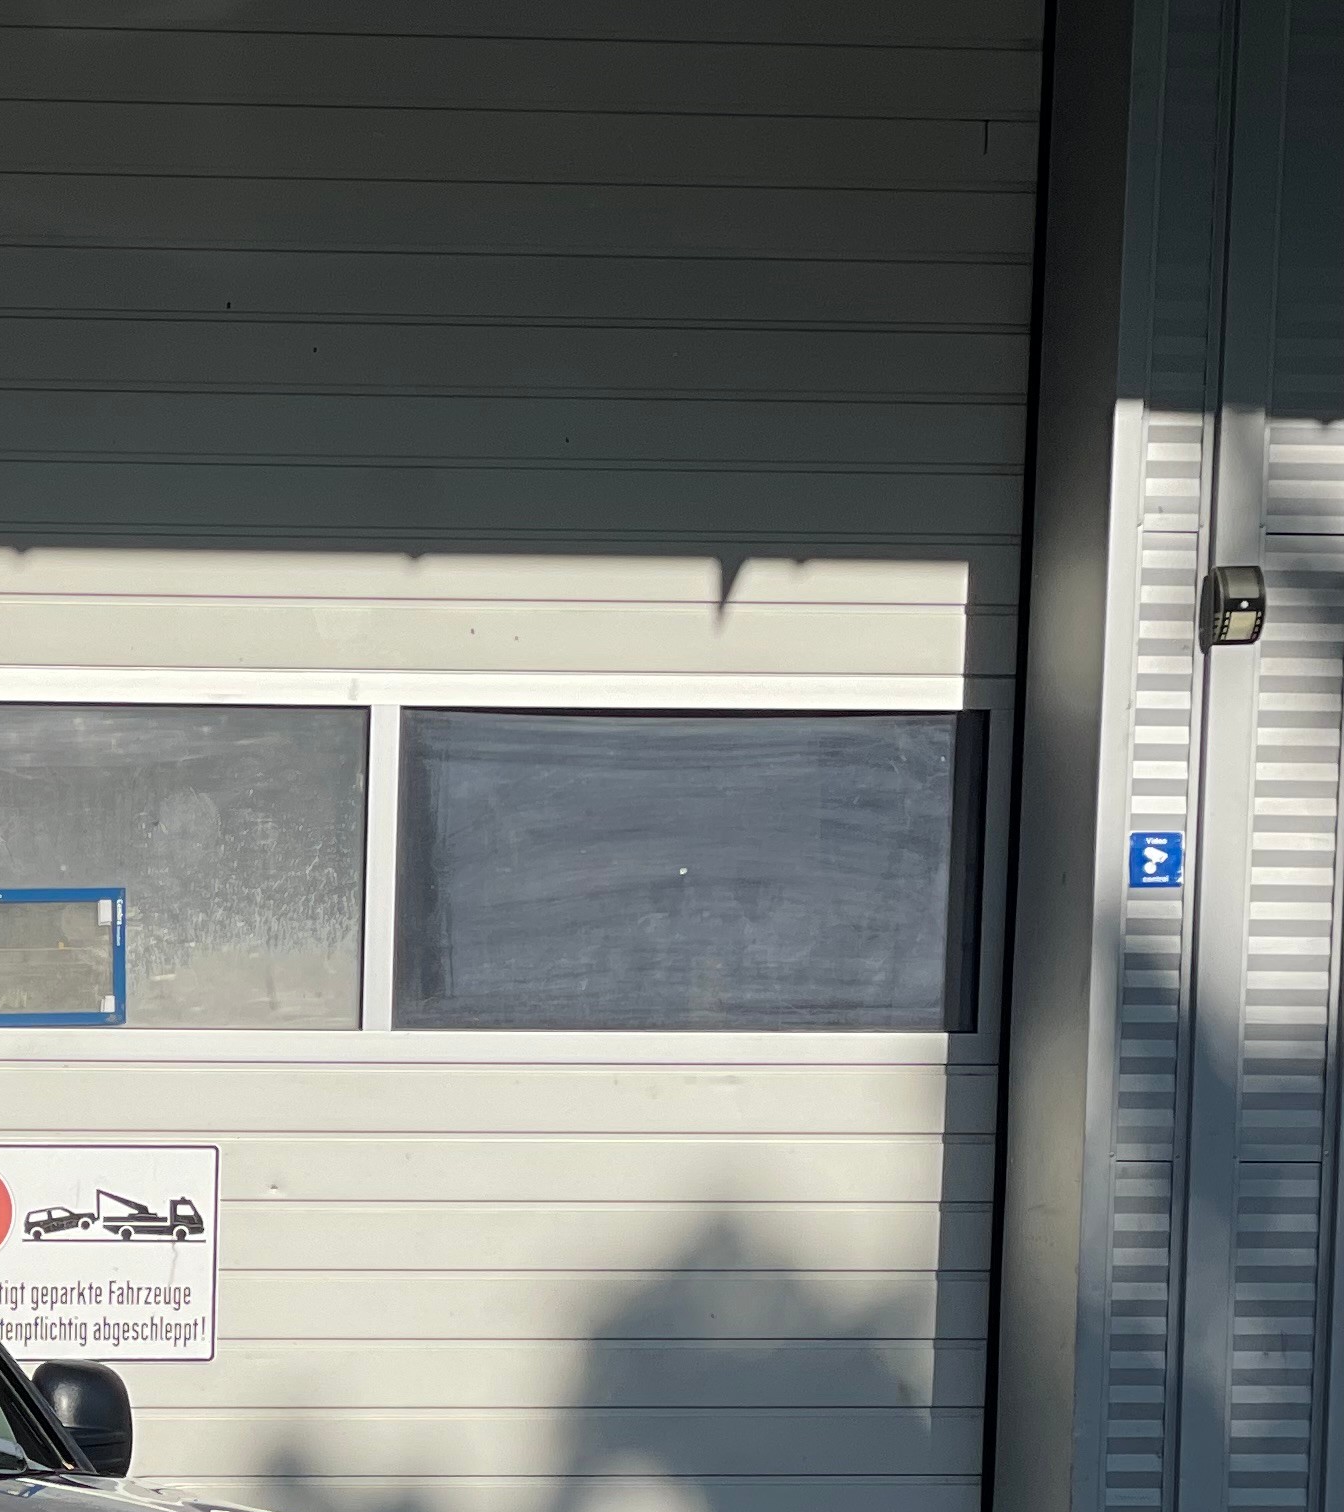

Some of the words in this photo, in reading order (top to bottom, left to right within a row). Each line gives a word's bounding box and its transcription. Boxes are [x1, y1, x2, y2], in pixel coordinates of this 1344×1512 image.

[30, 1280, 103, 1312] geparkte
[108, 1280, 192, 1311] Fahrzeuge
[93, 1316, 207, 1347] abgeschleppt!
